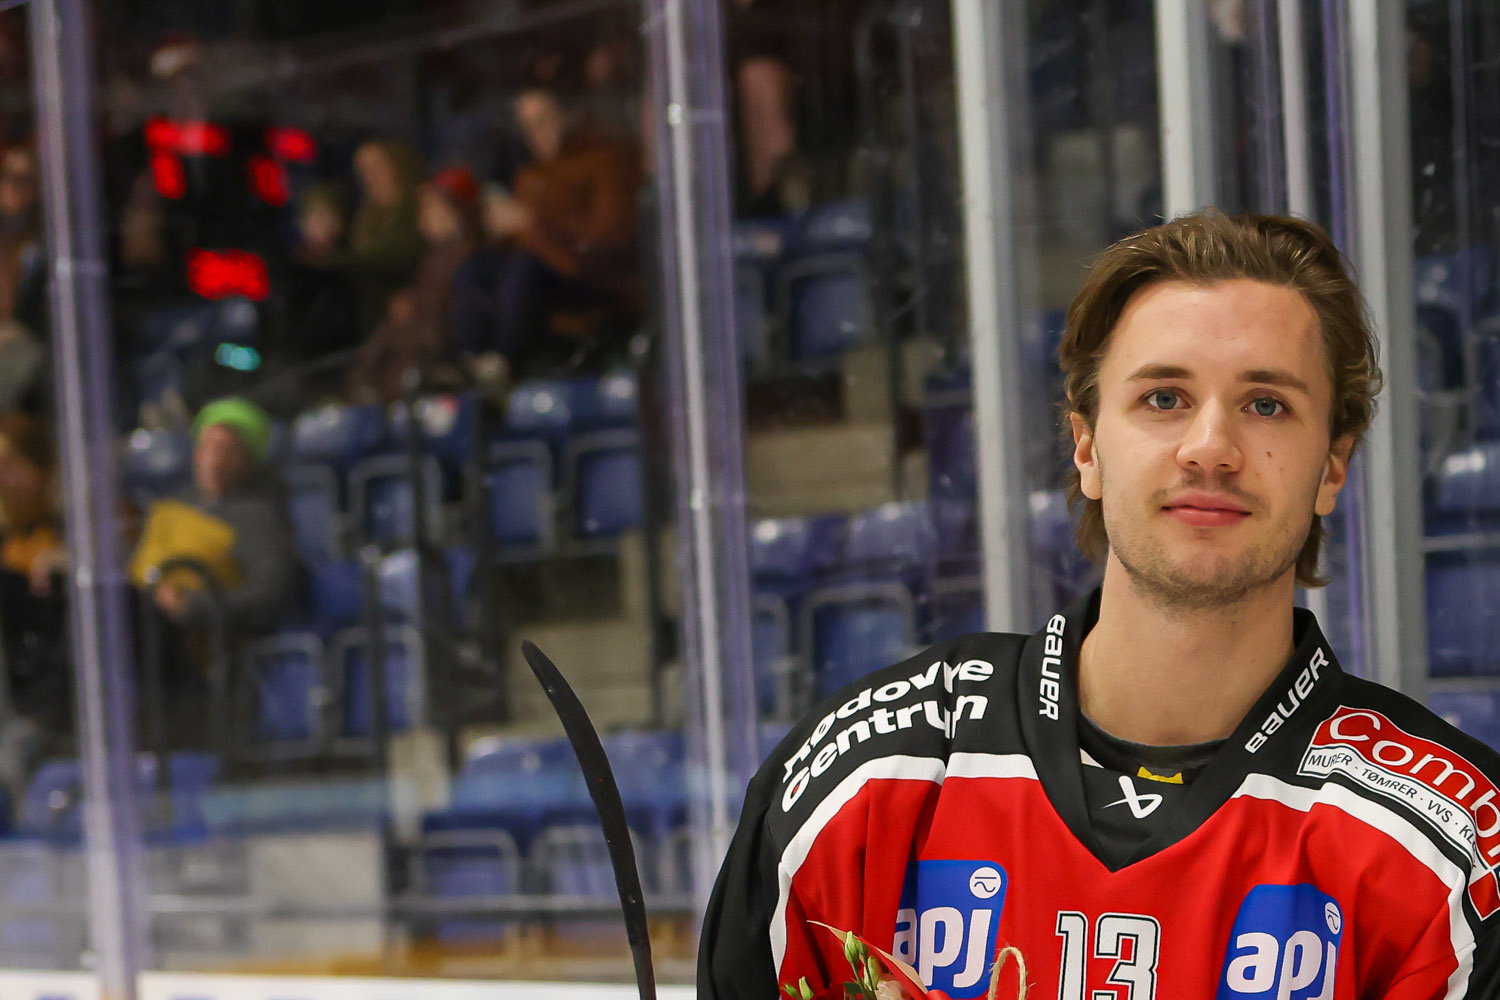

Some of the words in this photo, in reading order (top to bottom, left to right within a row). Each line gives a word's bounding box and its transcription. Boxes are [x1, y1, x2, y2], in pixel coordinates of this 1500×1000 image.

[1039, 614, 1066, 721] BAUER
[1244, 647, 1329, 754] BAUER
[1307, 752, 1353, 768] MURER
[1361, 768, 1418, 798] TØMRER
[1427, 799, 1453, 823] VVS
[892, 906, 993, 989] apj
